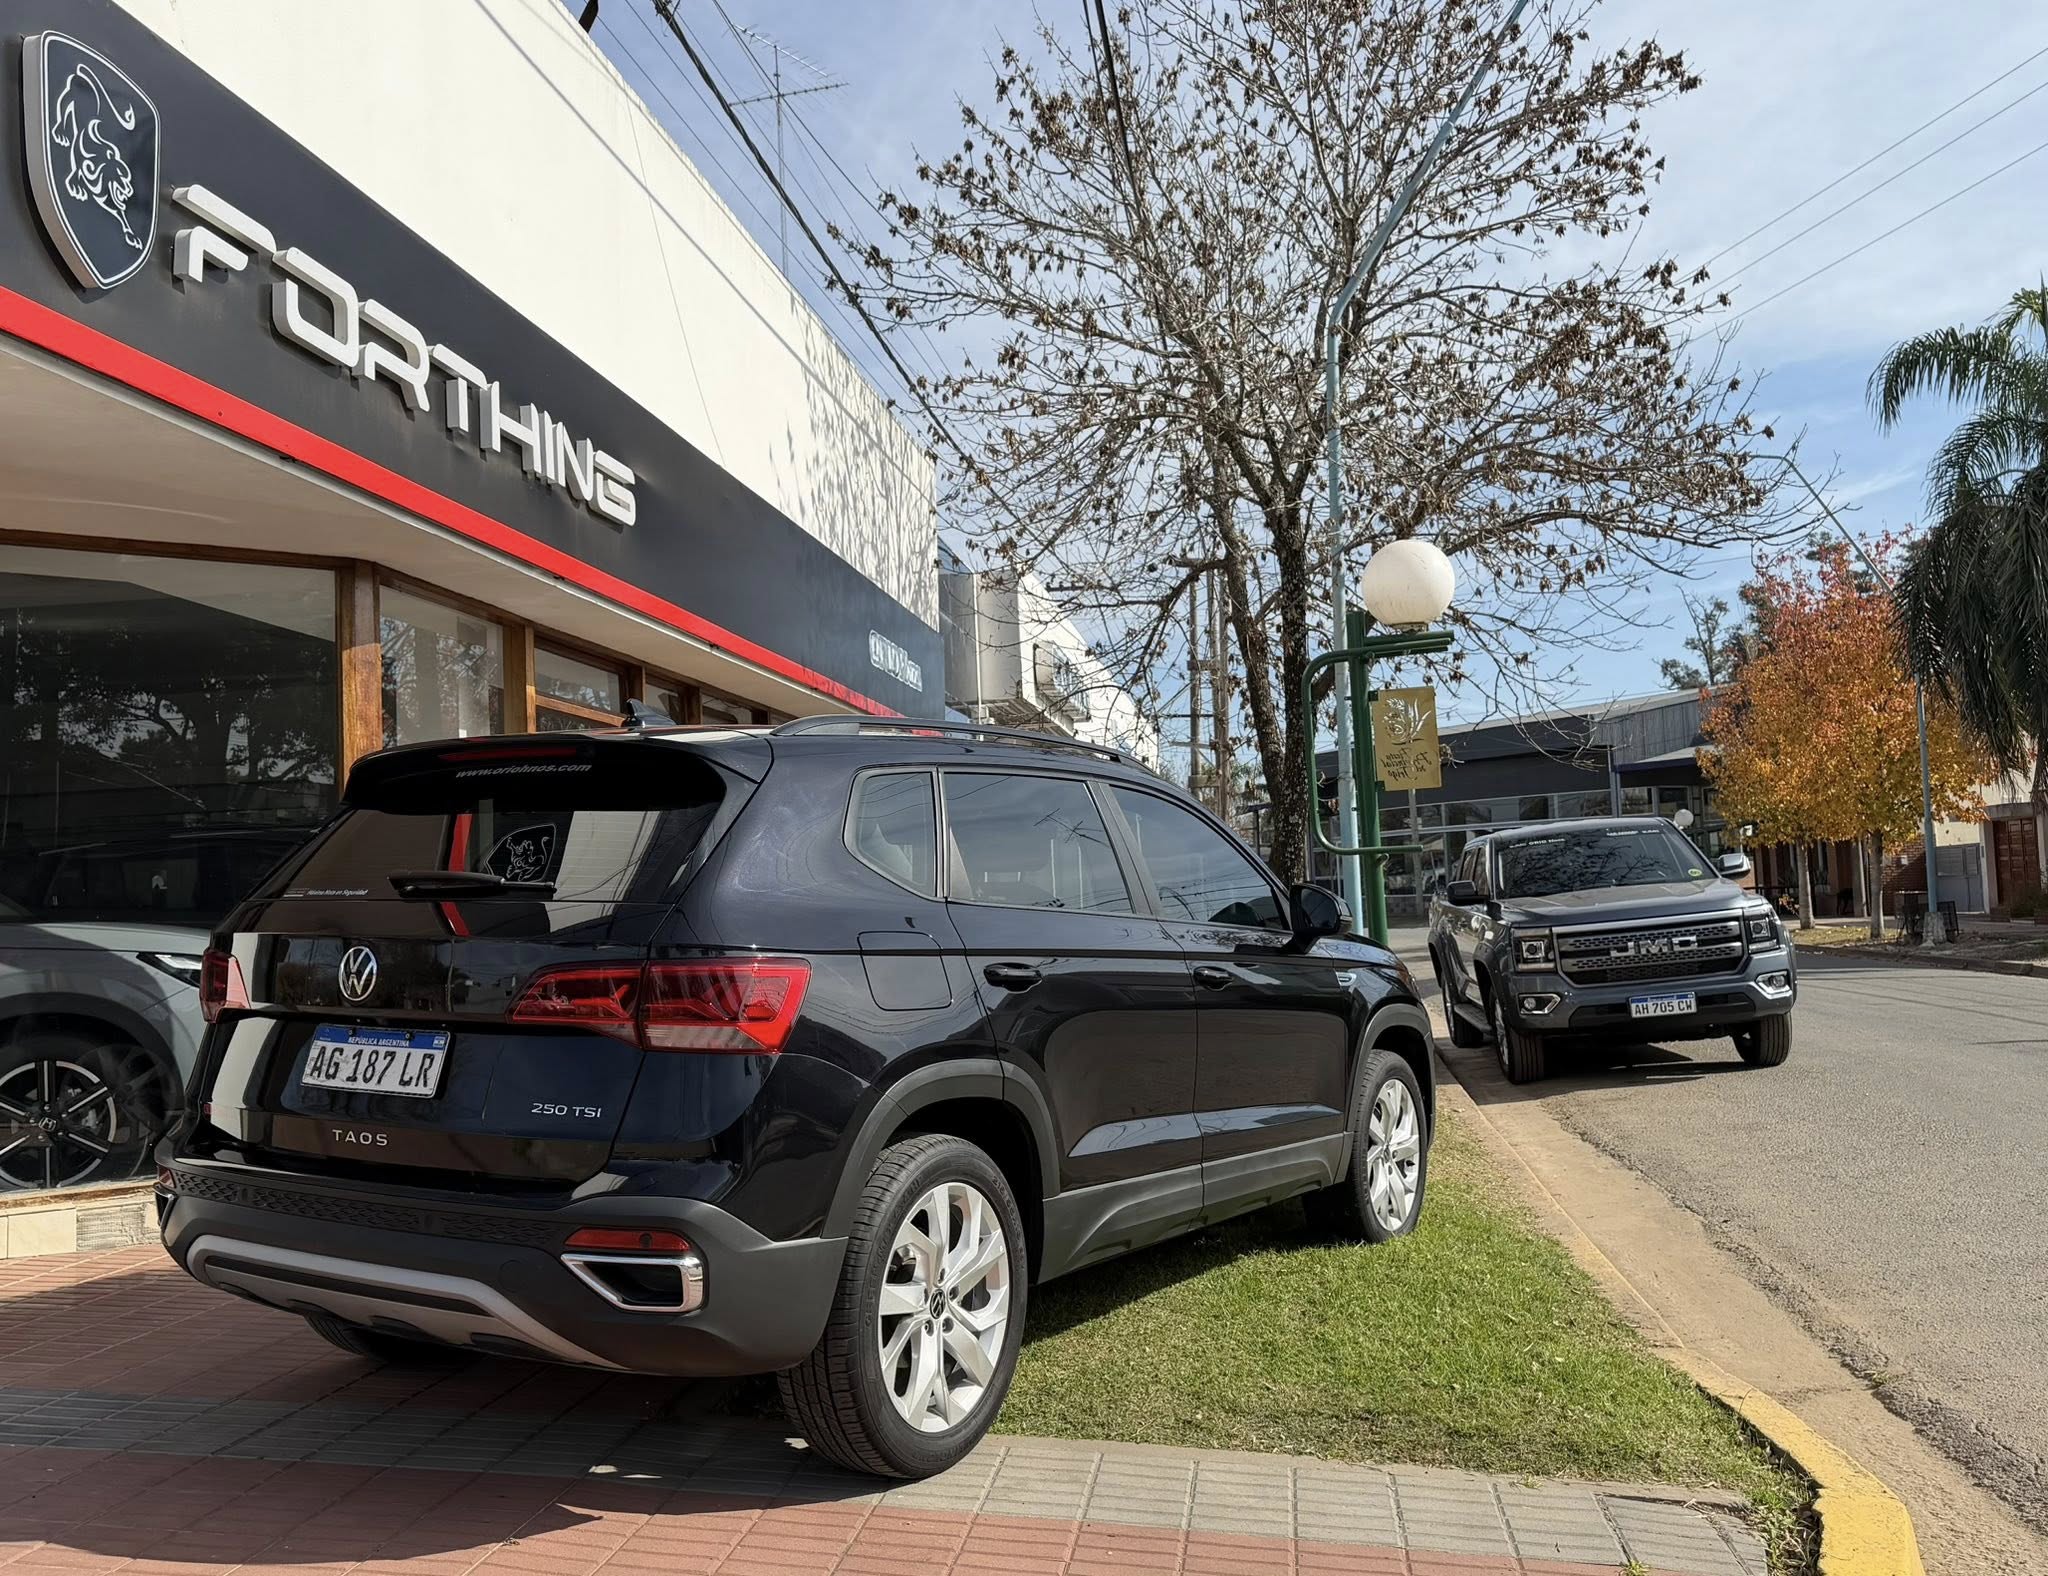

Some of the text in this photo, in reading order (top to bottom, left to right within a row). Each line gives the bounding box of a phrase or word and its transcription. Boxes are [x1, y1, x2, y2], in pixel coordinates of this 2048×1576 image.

[172, 184, 637, 527] FORTHING
[1634, 1003, 1650, 1016] AH
[1652, 1001, 1675, 1014] 705
[1678, 999, 1693, 1011] CW
[378, 1037, 410, 1048] ARGENTINA
[310, 1046, 436, 1088] AG 187 LR
[531, 1103, 602, 1118] 250 TSI
[332, 1129, 389, 1146] TAOS
